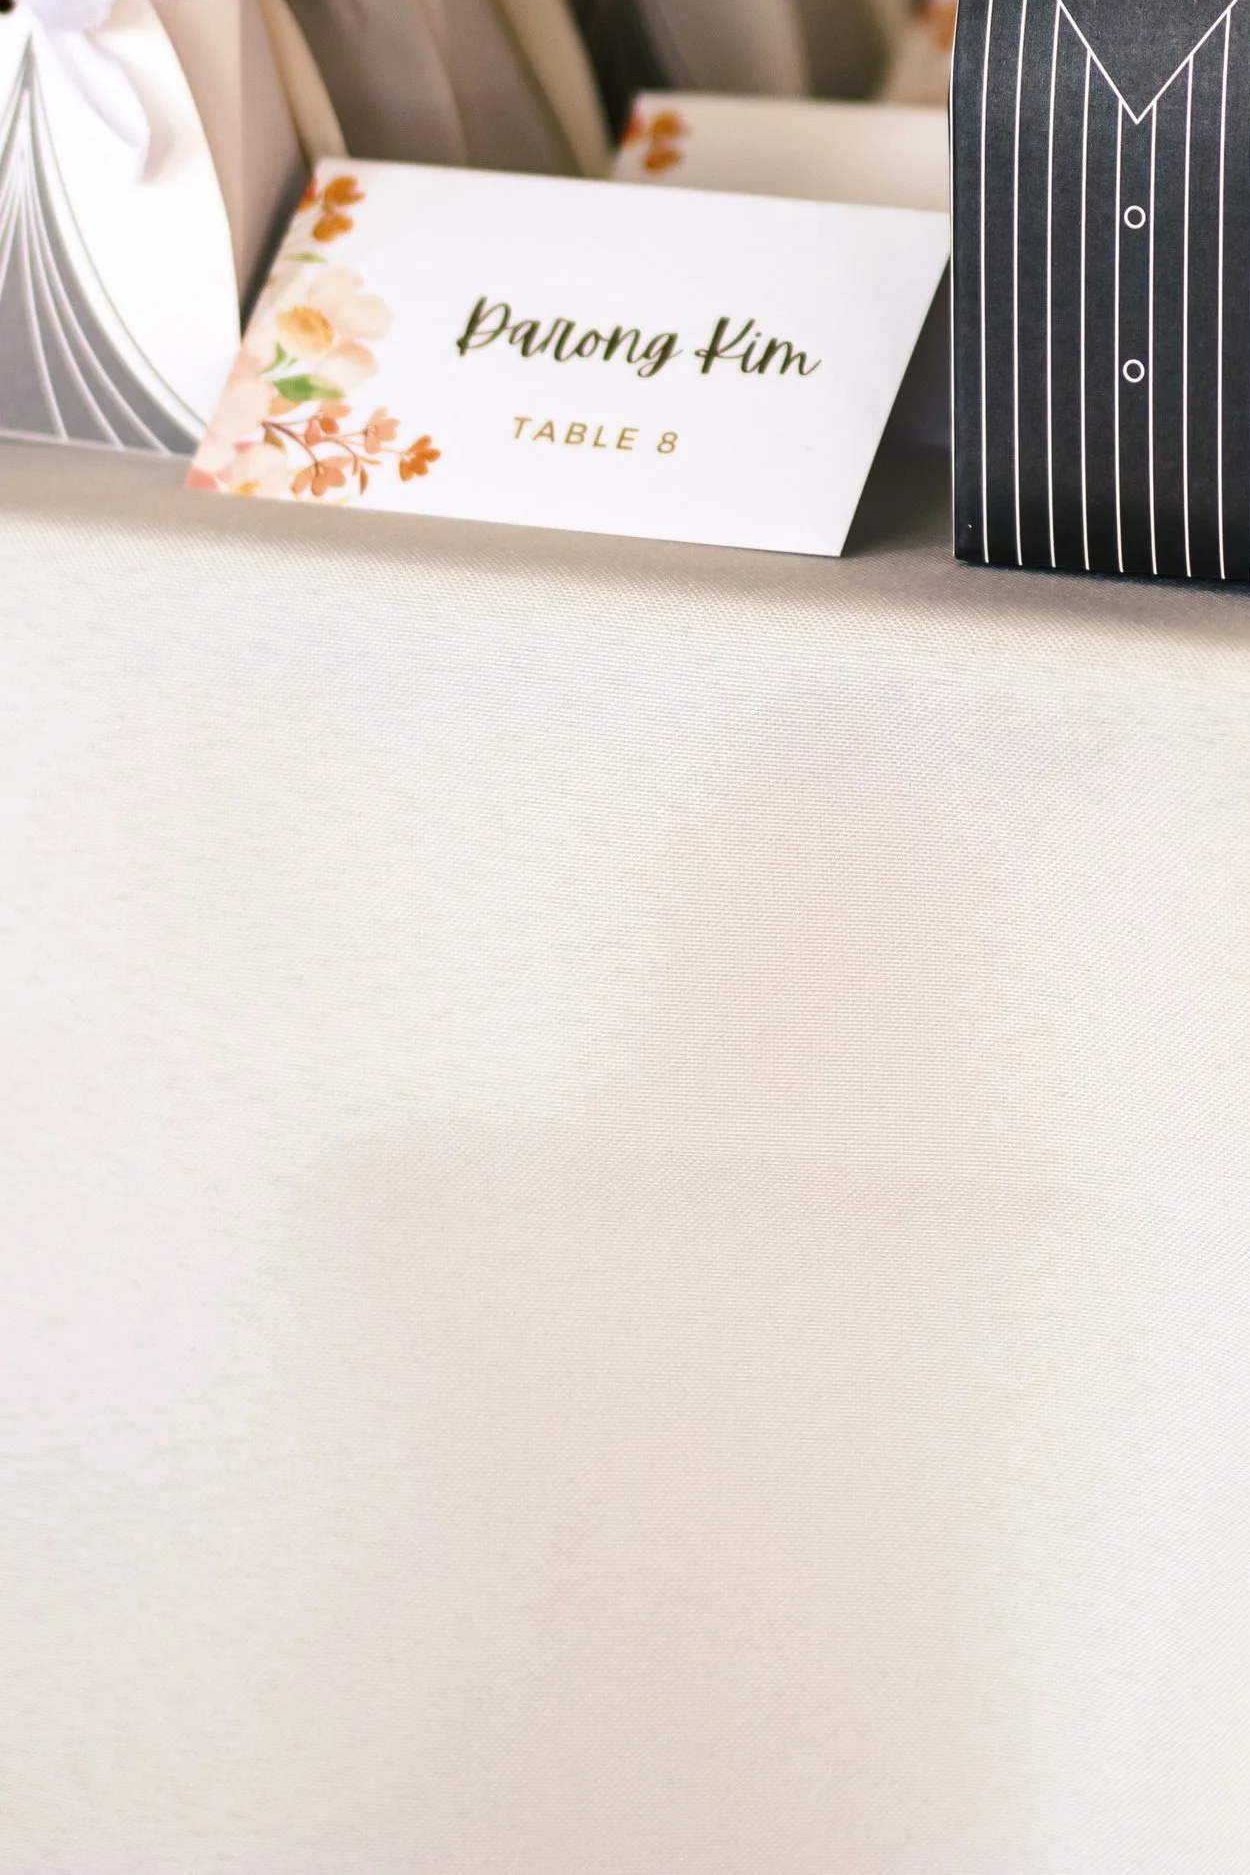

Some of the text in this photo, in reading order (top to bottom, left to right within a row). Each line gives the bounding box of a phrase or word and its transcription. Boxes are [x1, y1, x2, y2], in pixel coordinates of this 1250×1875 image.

[694, 316, 822, 377] Kim
[513, 416, 678, 455] TABLE 8
